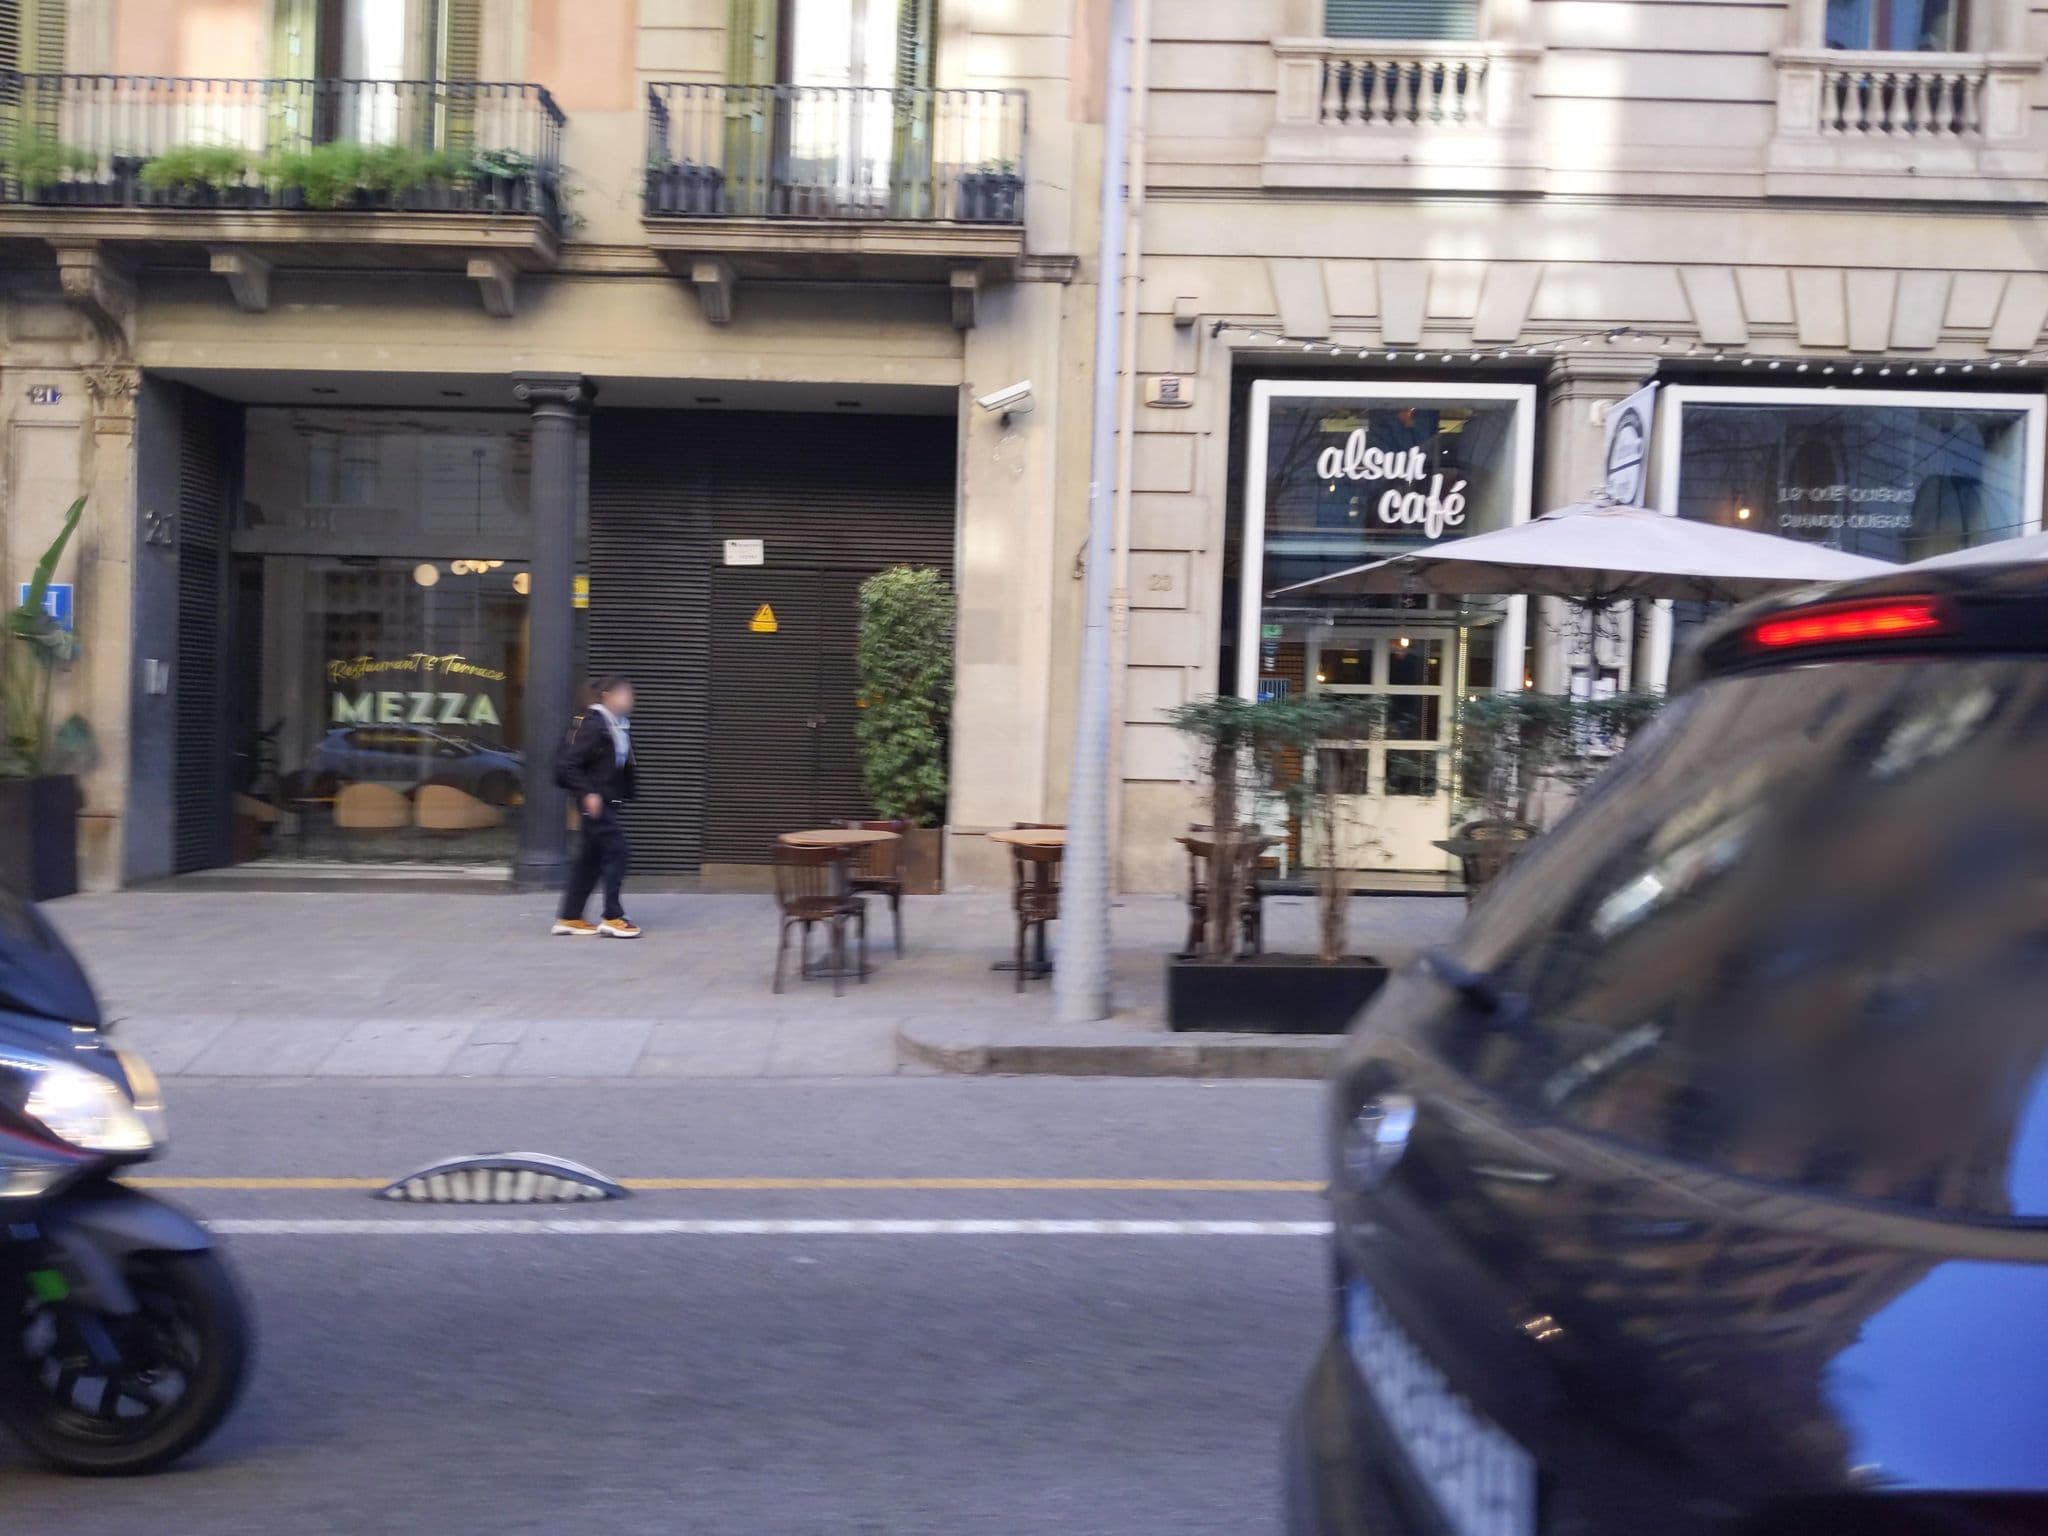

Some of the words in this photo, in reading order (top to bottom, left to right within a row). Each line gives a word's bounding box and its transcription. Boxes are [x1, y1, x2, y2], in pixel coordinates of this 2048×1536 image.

[1317, 428, 1426, 481] alsur
[1378, 473, 1467, 539] café
[333, 691, 501, 726] MEZZA
